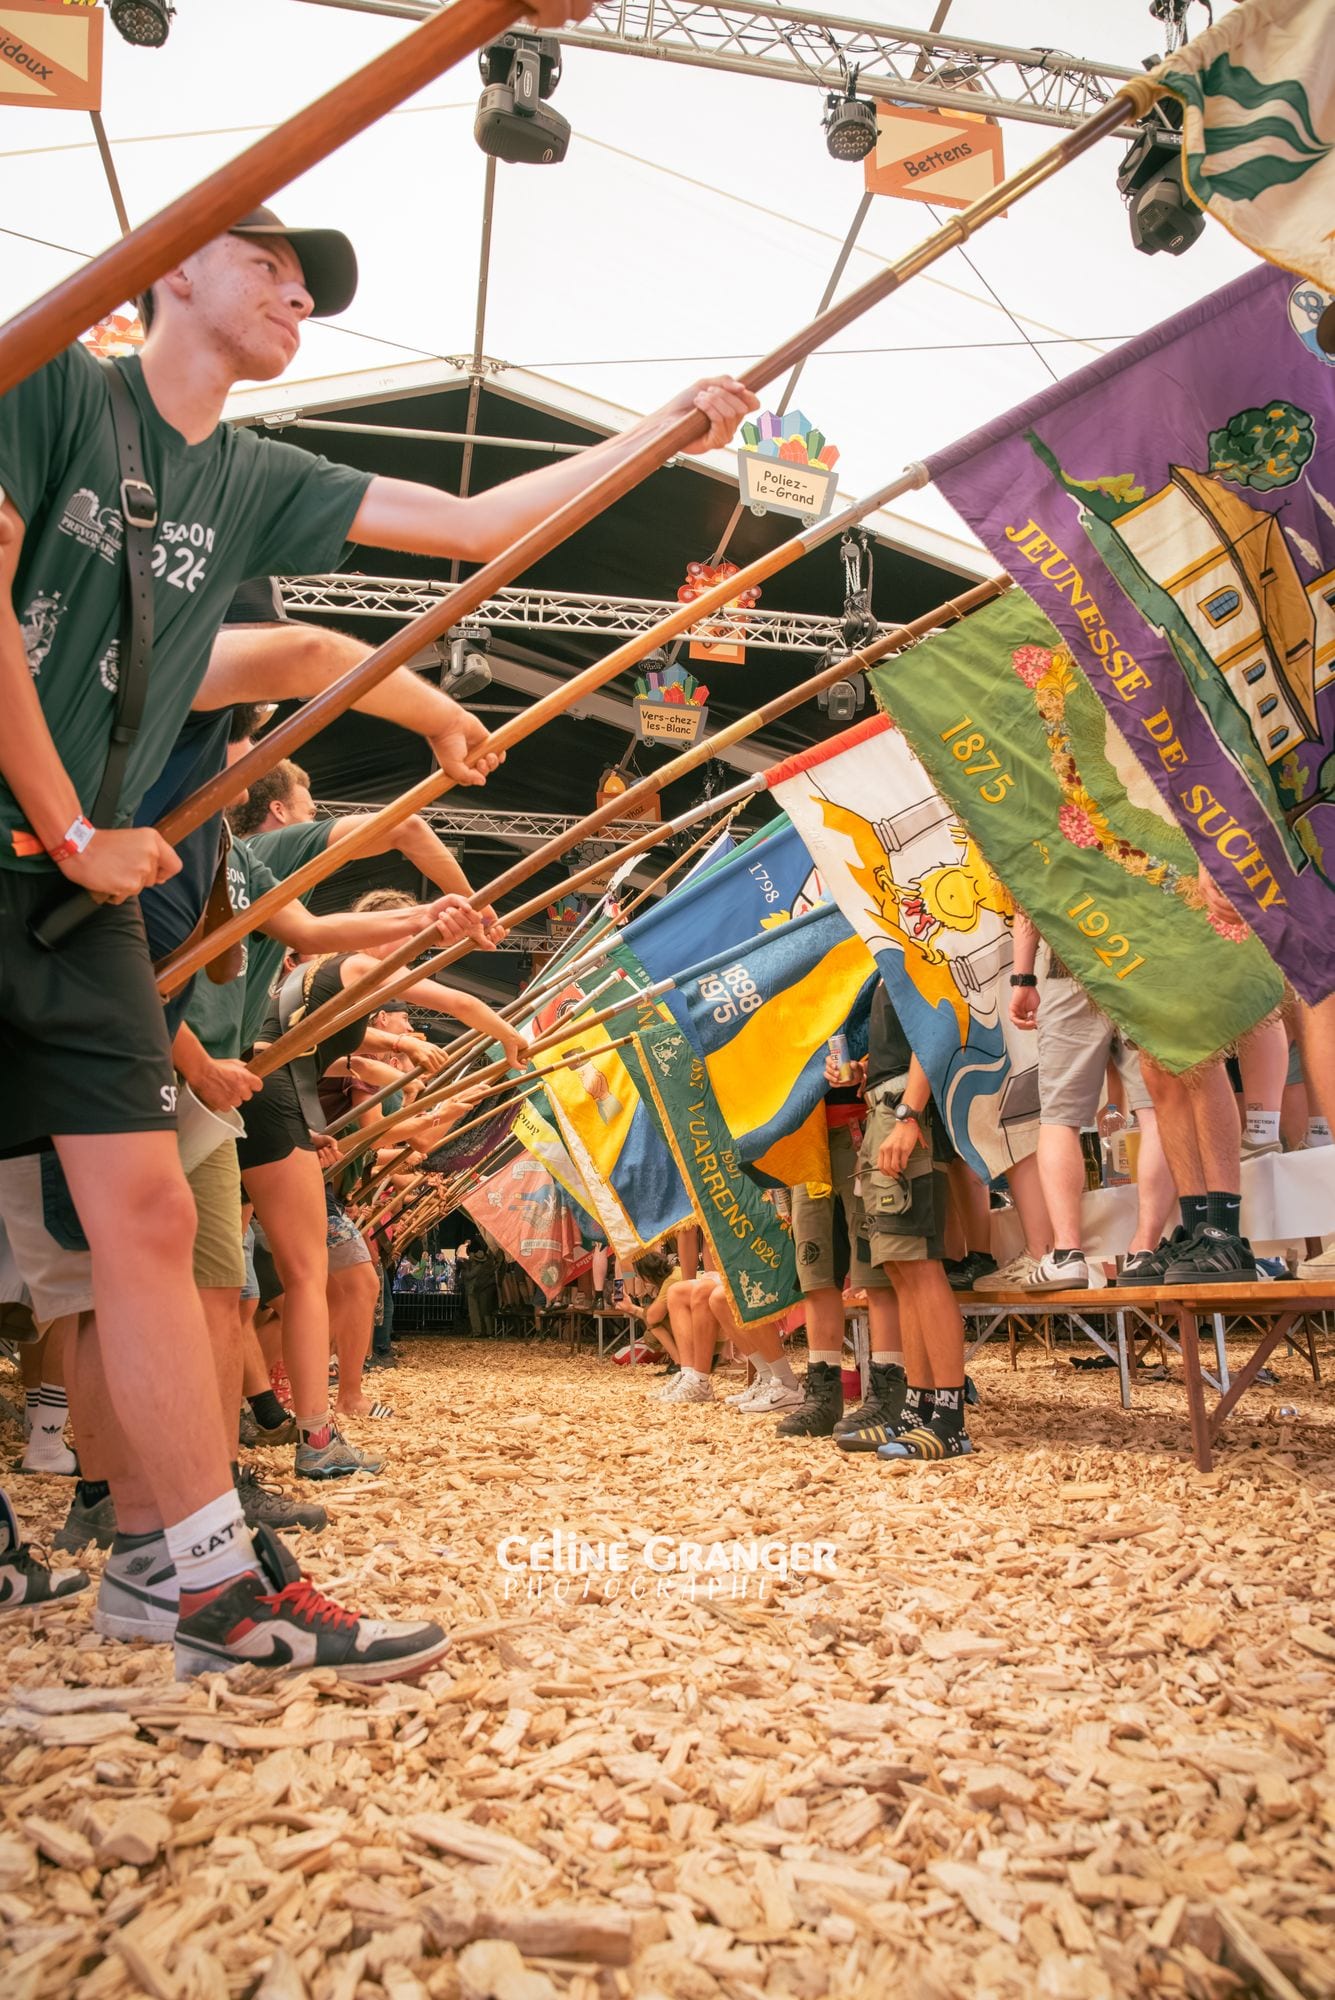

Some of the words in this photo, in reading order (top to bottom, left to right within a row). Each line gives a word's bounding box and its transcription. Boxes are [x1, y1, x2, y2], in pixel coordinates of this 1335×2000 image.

[0, 36, 53, 80] idoux
[903, 142, 973, 177] Bettens
[756, 480, 814, 505] le-Grand
[764, 470, 808, 489] Poliez-
[641, 710, 697, 725] Vers-chez-
[646, 721, 691, 735] les-Blanc
[1005, 518, 1152, 702] JEUNESSE
[1140, 705, 1189, 773] DE
[1180, 784, 1287, 913] SUCHY
[940, 714, 1016, 804] 1875
[748, 862, 780, 903] 1798
[1066, 892, 1146, 980] 1921
[697, 973, 739, 1024] 1975
[720, 963, 763, 1013] 1898
[687, 1100, 754, 1239] VUARRENS
[191, 1522, 235, 1557] CAT
